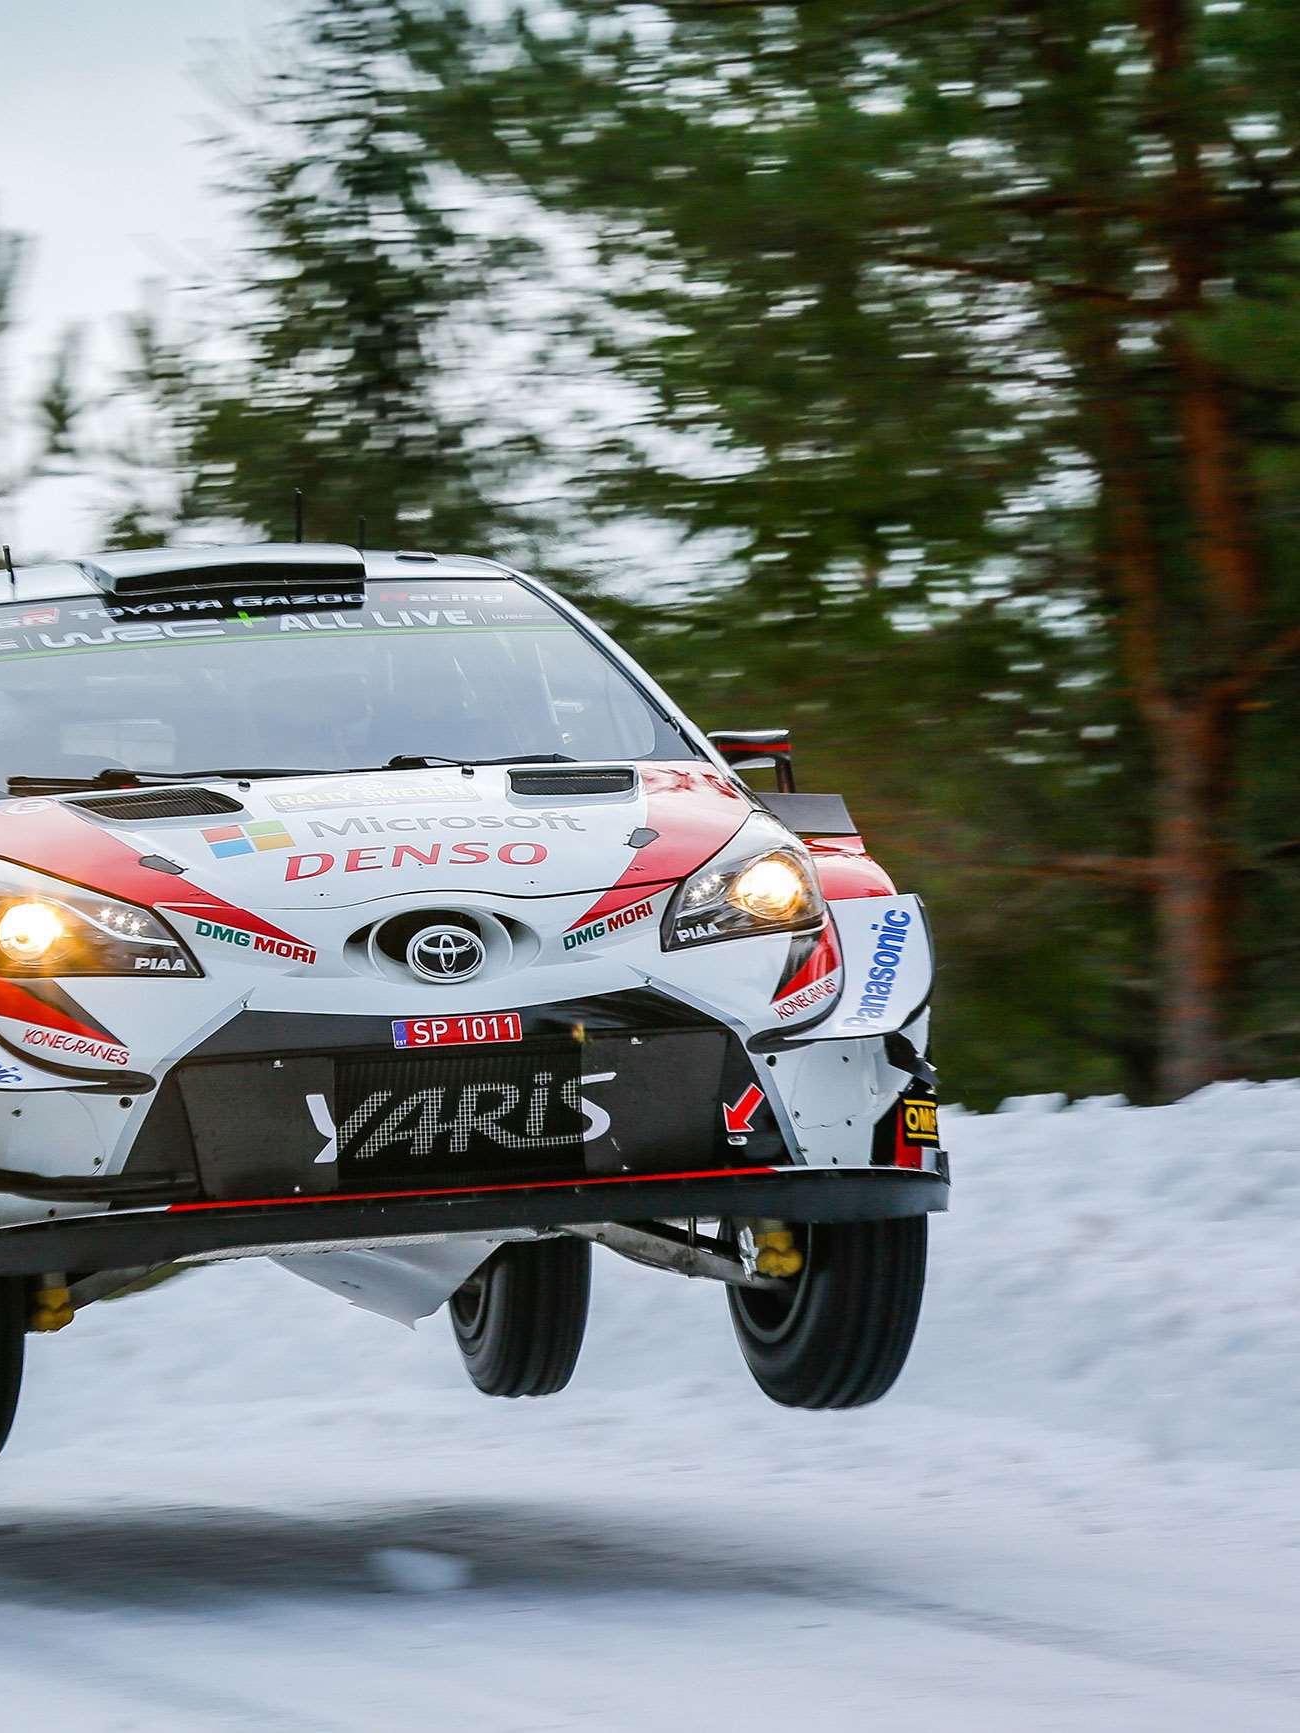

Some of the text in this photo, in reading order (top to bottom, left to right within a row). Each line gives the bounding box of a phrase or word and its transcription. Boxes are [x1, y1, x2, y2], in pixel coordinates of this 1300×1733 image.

[69, 599, 223, 620] TOYOTA
[232, 594, 368, 608] GAZOO
[279, 611, 363, 632] ALL
[371, 609, 473, 628] LIVE
[276, 783, 469, 807] RALLY SWEDEN
[307, 811, 587, 838] Microsoft
[284, 841, 548, 882] DENSO
[562, 901, 653, 951] DMG MORI
[676, 922, 722, 943] PIAA
[195, 920, 317, 965] DMG MORI
[134, 957, 188, 972] PIAA
[843, 909, 911, 1030] Panasonic
[413, 1016, 515, 1044] SP 1011
[22, 1028, 131, 1066] KONECRANES
